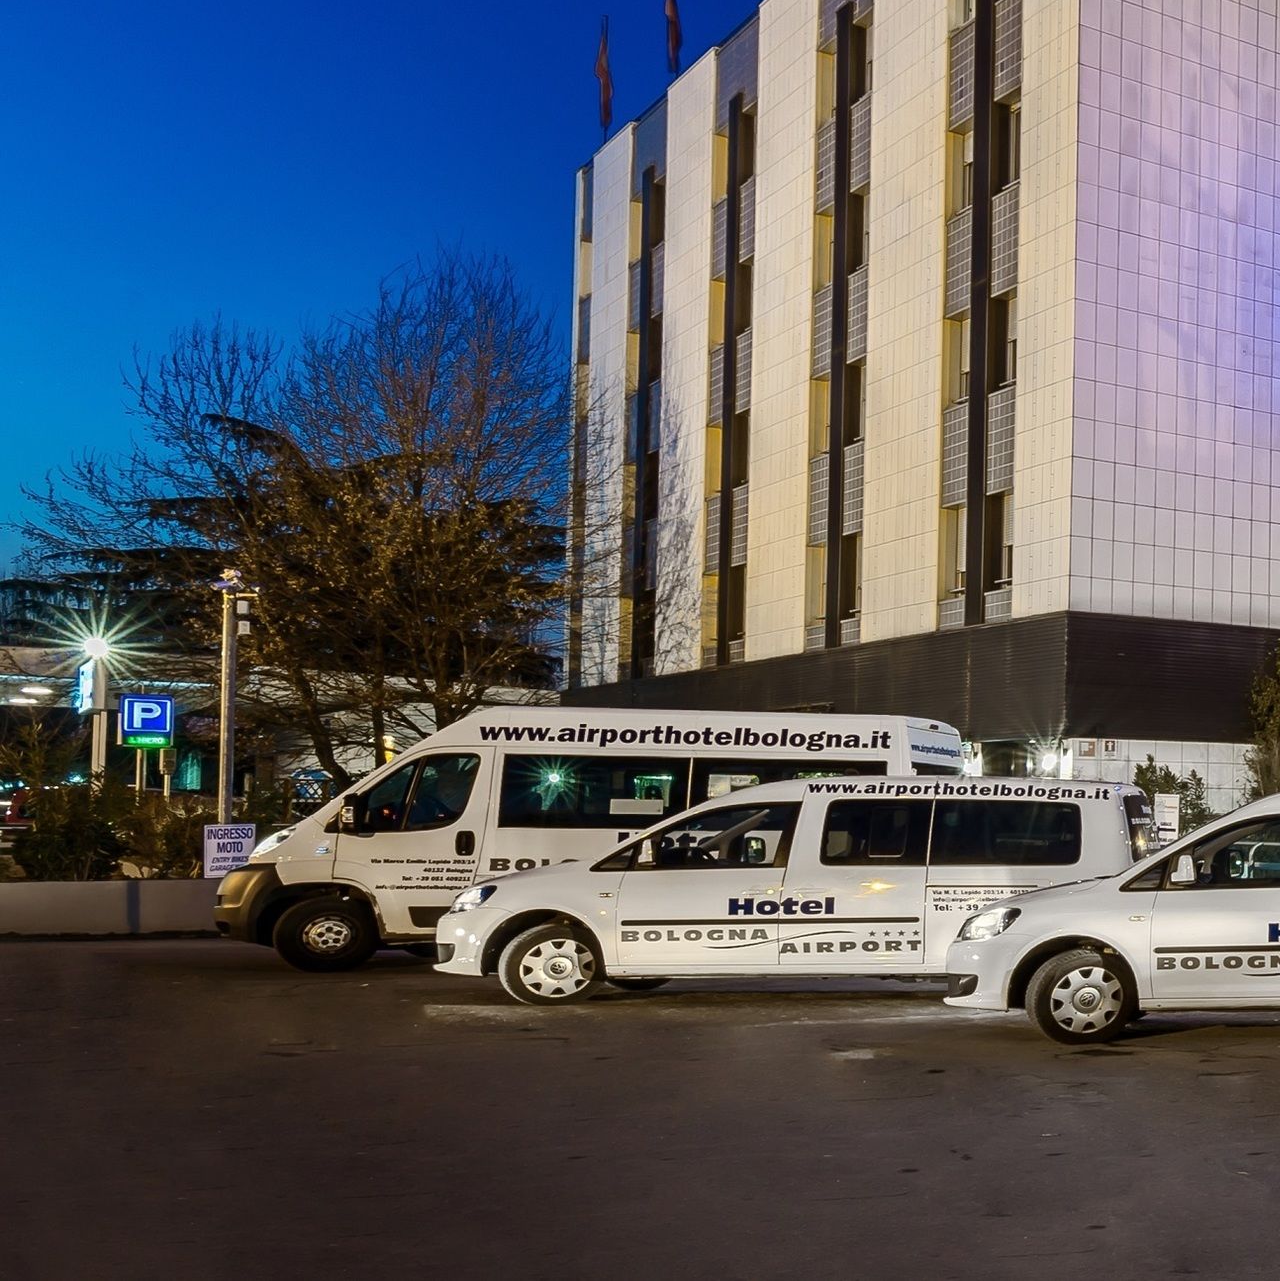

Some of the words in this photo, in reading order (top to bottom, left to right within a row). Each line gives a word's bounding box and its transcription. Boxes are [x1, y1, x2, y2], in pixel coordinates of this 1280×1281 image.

[133, 702, 162, 728] P
[479, 721, 892, 751] www.airporthotelbologna.it
[808, 782, 1111, 801] www.airporthotelbologna.it
[207, 828, 253, 840] INGRESSO
[216, 841, 243, 853] MOTO
[728, 896, 836, 916] Hotel
[620, 928, 769, 943] BOLOGNA
[779, 940, 922, 955] AIRPORT
